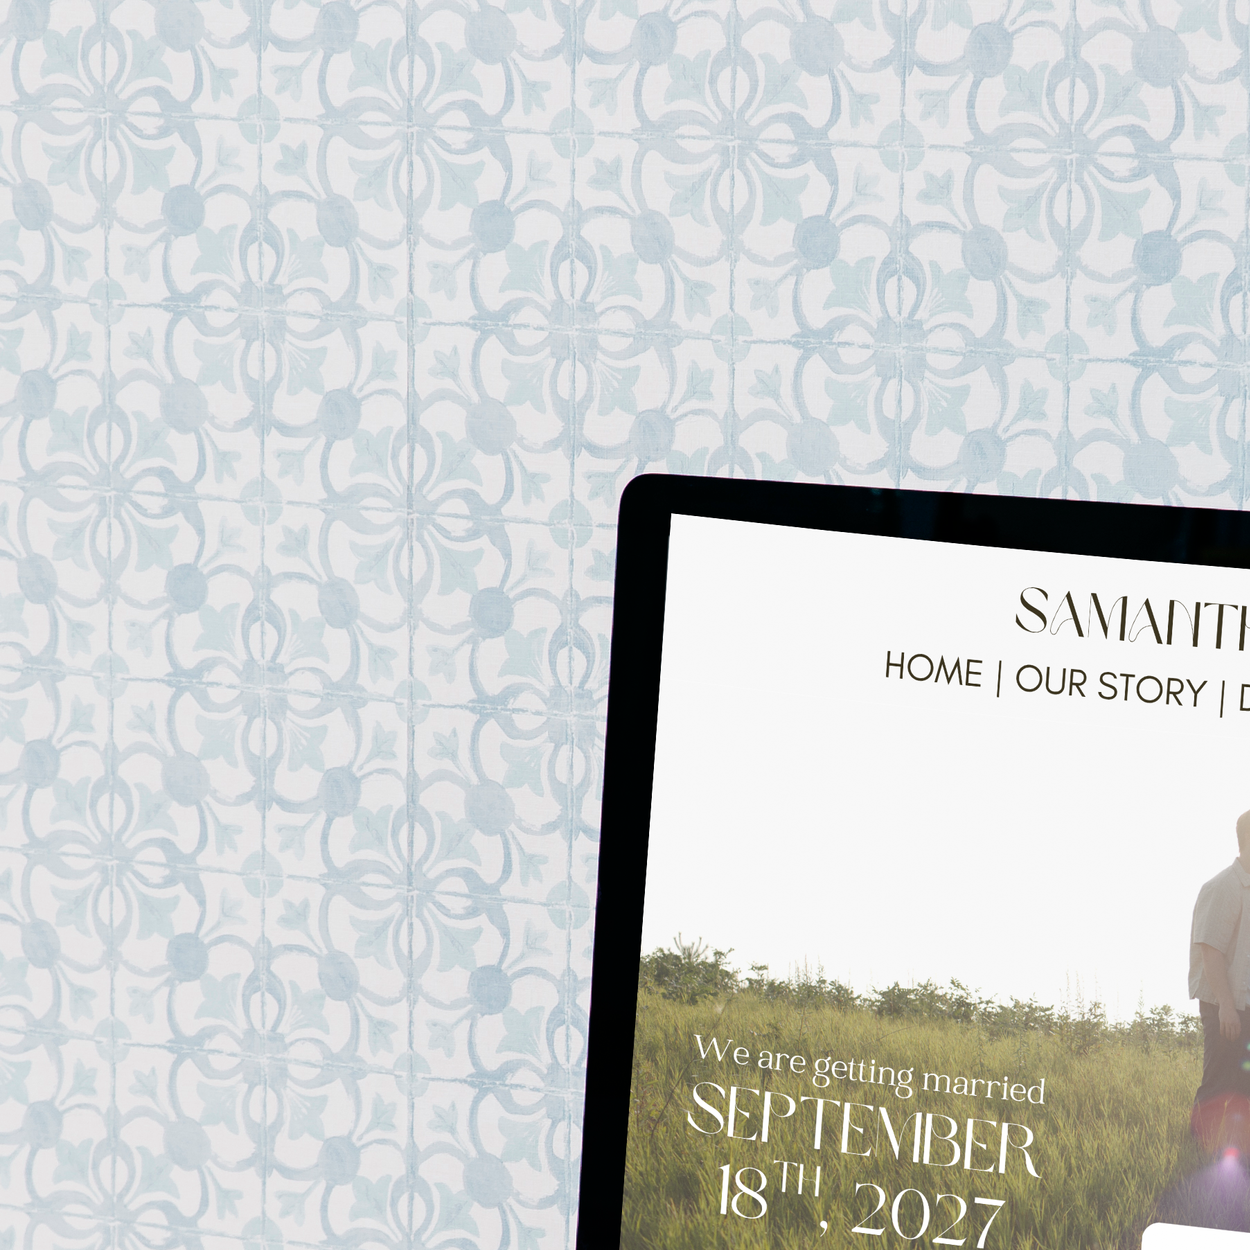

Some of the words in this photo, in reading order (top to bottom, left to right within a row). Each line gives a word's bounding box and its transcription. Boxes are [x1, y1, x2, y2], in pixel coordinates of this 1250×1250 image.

[885, 650, 983, 688] HOME
[1015, 664, 1087, 698] OUR
[1097, 671, 1208, 708] STORY
[694, 1034, 750, 1066] We
[757, 1050, 806, 1074] are
[812, 1056, 914, 1099] getting
[922, 1072, 1046, 1105] married
[687, 1081, 1042, 1179] SEPTEMBER
[851, 1183, 1006, 1249] 2027
